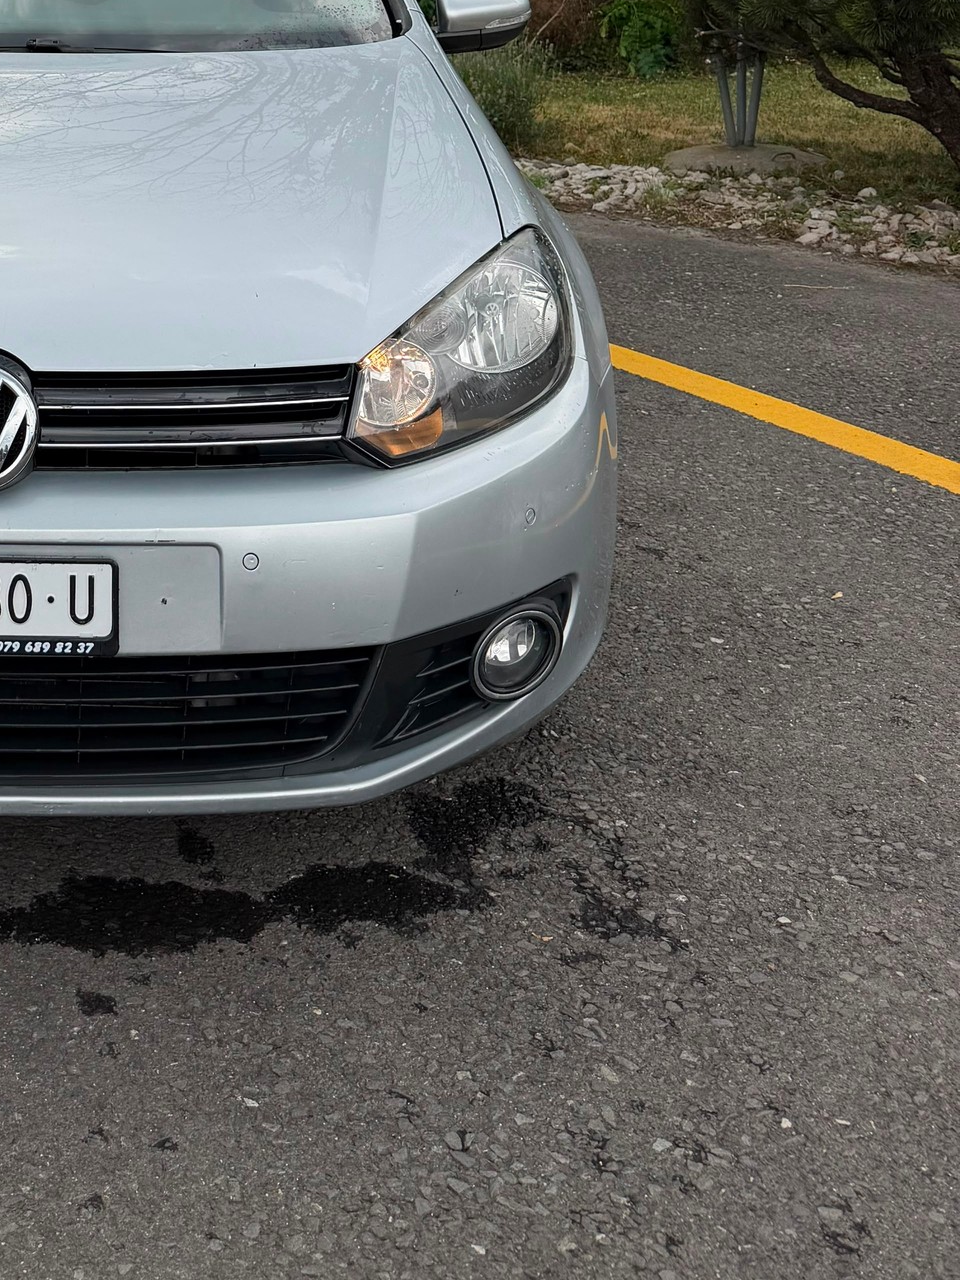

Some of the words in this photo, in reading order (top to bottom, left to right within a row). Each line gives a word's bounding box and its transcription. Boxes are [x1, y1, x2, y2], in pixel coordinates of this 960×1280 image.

[24, 641, 51, 653] 689
[55, 642, 72, 654] 82
[76, 642, 95, 654] 37
